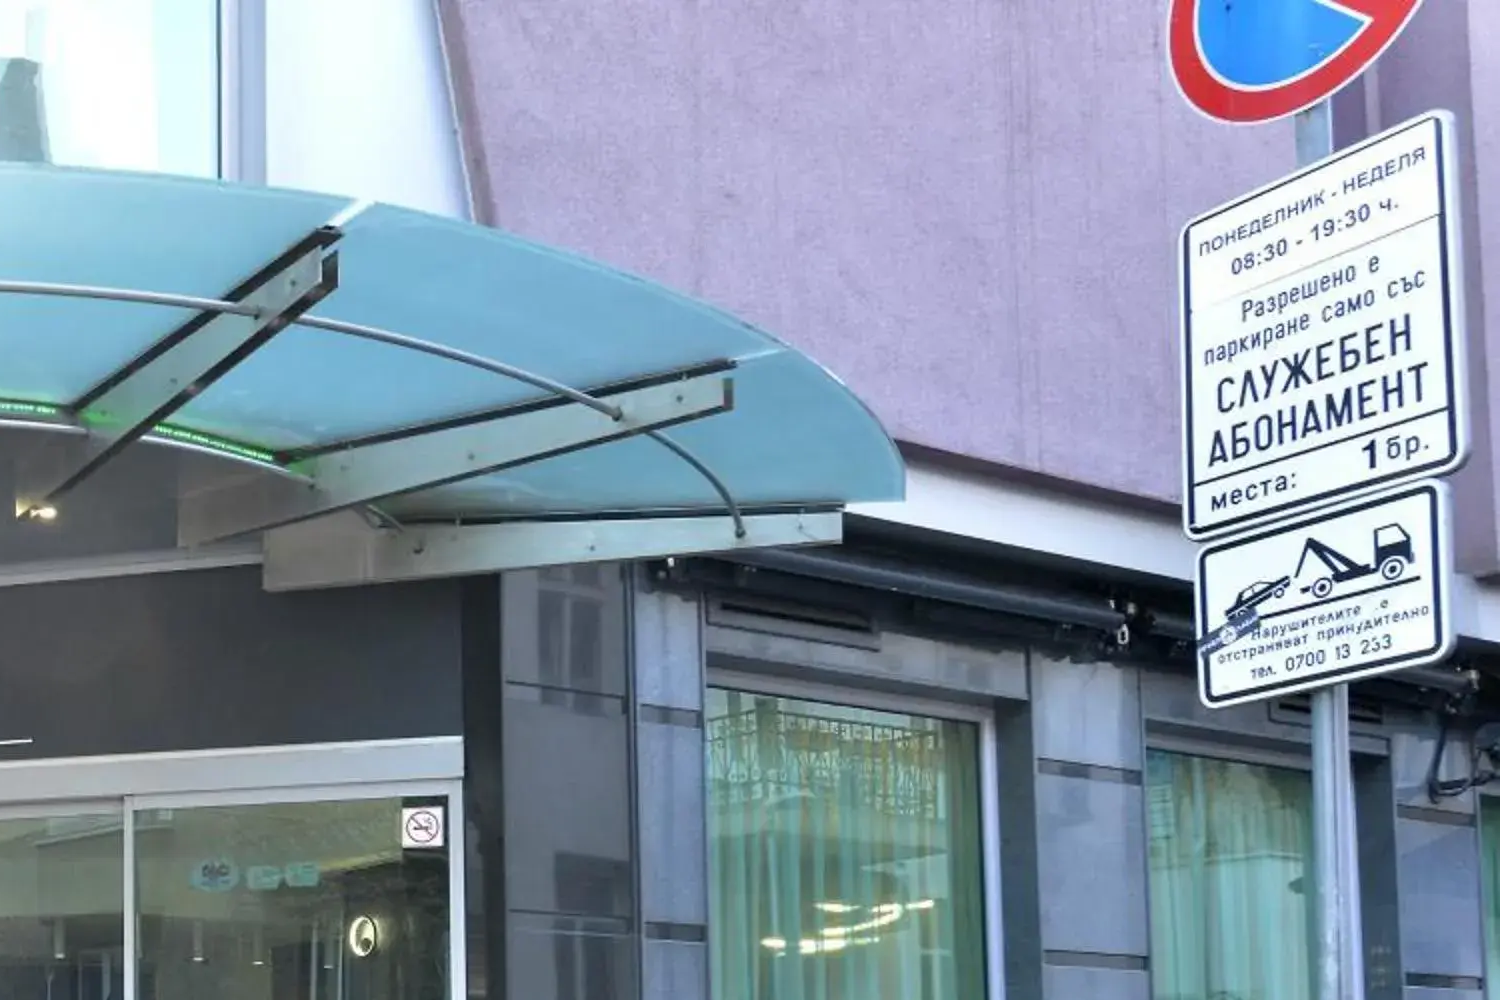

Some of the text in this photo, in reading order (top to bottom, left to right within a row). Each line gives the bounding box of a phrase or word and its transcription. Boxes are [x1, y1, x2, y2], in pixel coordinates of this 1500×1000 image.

[1199, 190, 1325, 256] ПОНЕДЕЛНИК
[1343, 147, 1426, 194] НЕДЕЛЯ
[1231, 239, 1287, 276] 08:30
[1310, 204, 1370, 241] 19:30
[1379, 197, 1400, 212] ч.
[1204, 269, 1426, 366] паркиране само със
[1241, 255, 1380, 322] Разрешено е
[1217, 313, 1412, 413] СЛУЖЕБЕН
[1208, 362, 1428, 467] АБОНАМЕНТ
[1211, 472, 1297, 511] места:
[1218, 634, 1308, 664] отстраняват
[1317, 605, 1429, 641] принудително
[1251, 605, 1361, 641] Нарушителите
[1251, 667, 1277, 680] тел.
[1285, 650, 1326, 673] 0700
[1335, 643, 1351, 661] 13
